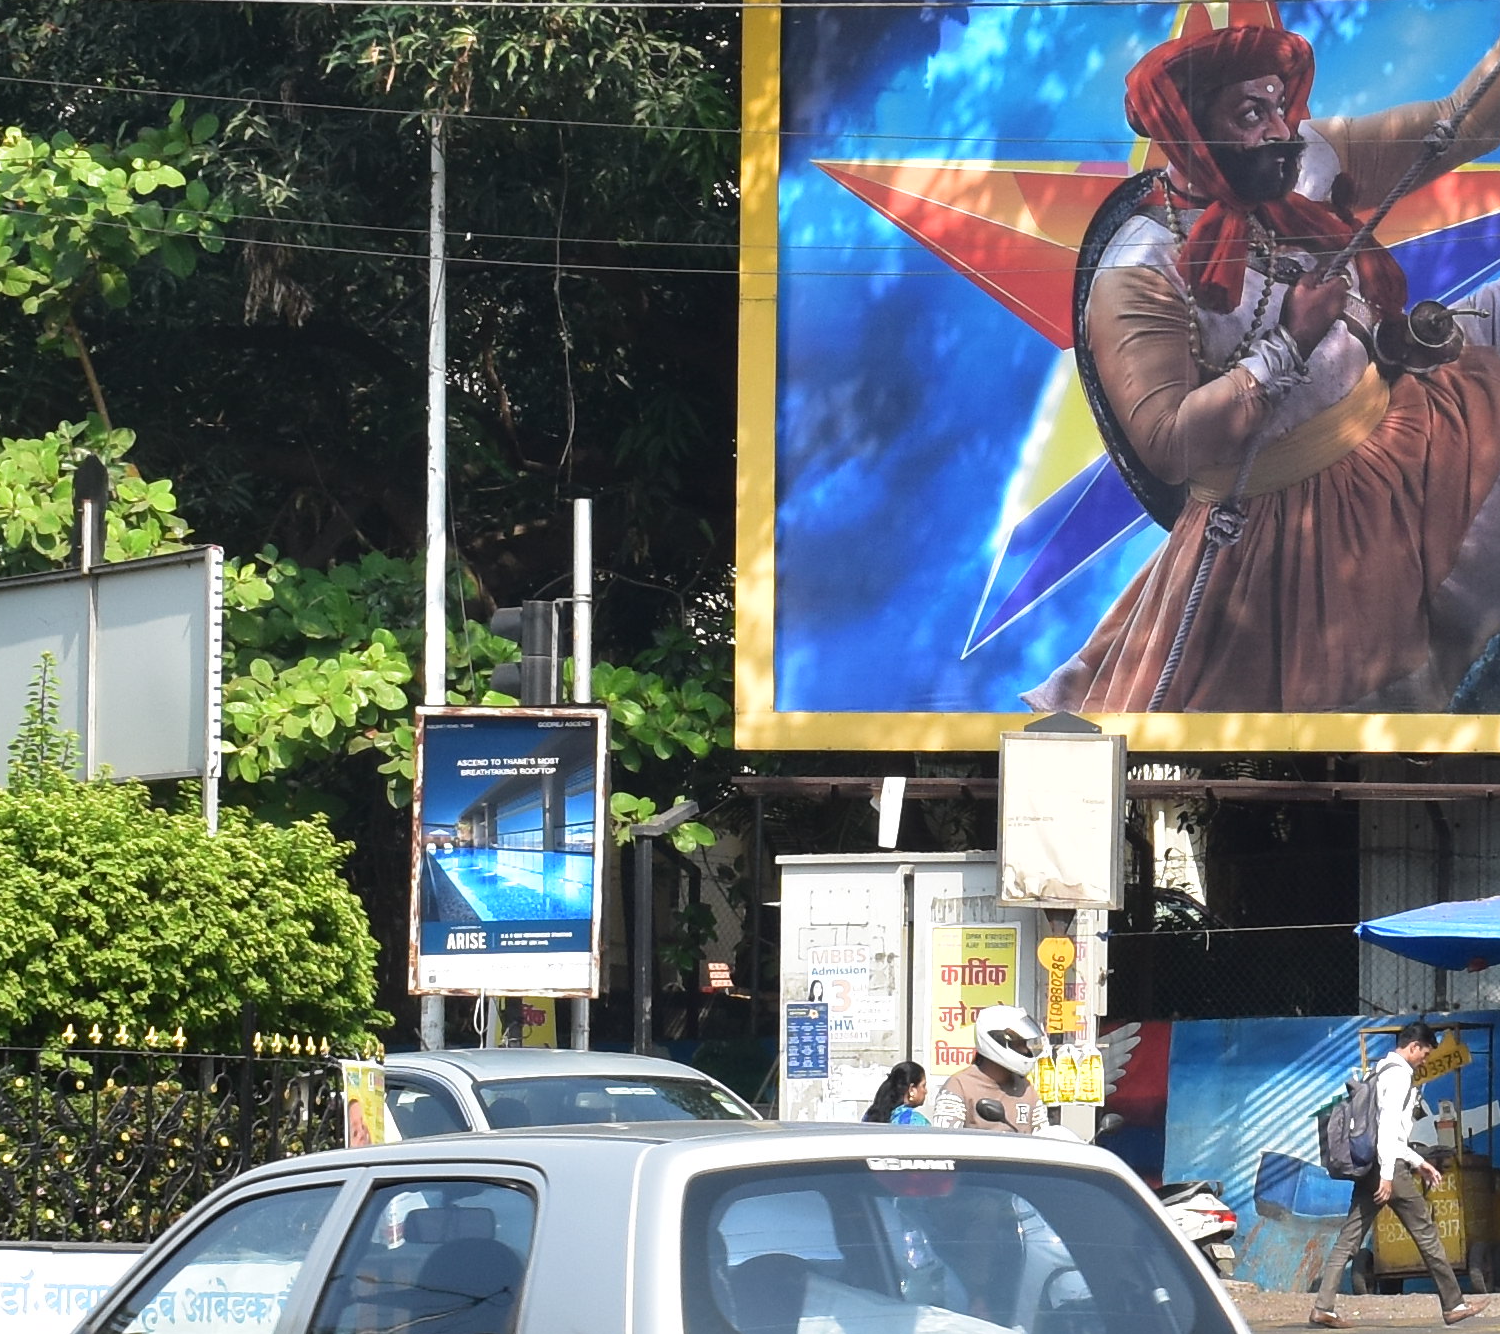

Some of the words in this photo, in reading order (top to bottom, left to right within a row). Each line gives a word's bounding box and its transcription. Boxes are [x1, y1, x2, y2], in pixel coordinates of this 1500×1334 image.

[456, 758, 489, 767] ASCEND
[490, 758, 501, 766] TO
[446, 931, 487, 950] ARISE
[811, 948, 867, 965] MBBS
[811, 966, 867, 976] Admission
[940, 957, 1009, 986] कार्तिक
[831, 979, 852, 1013] 3
